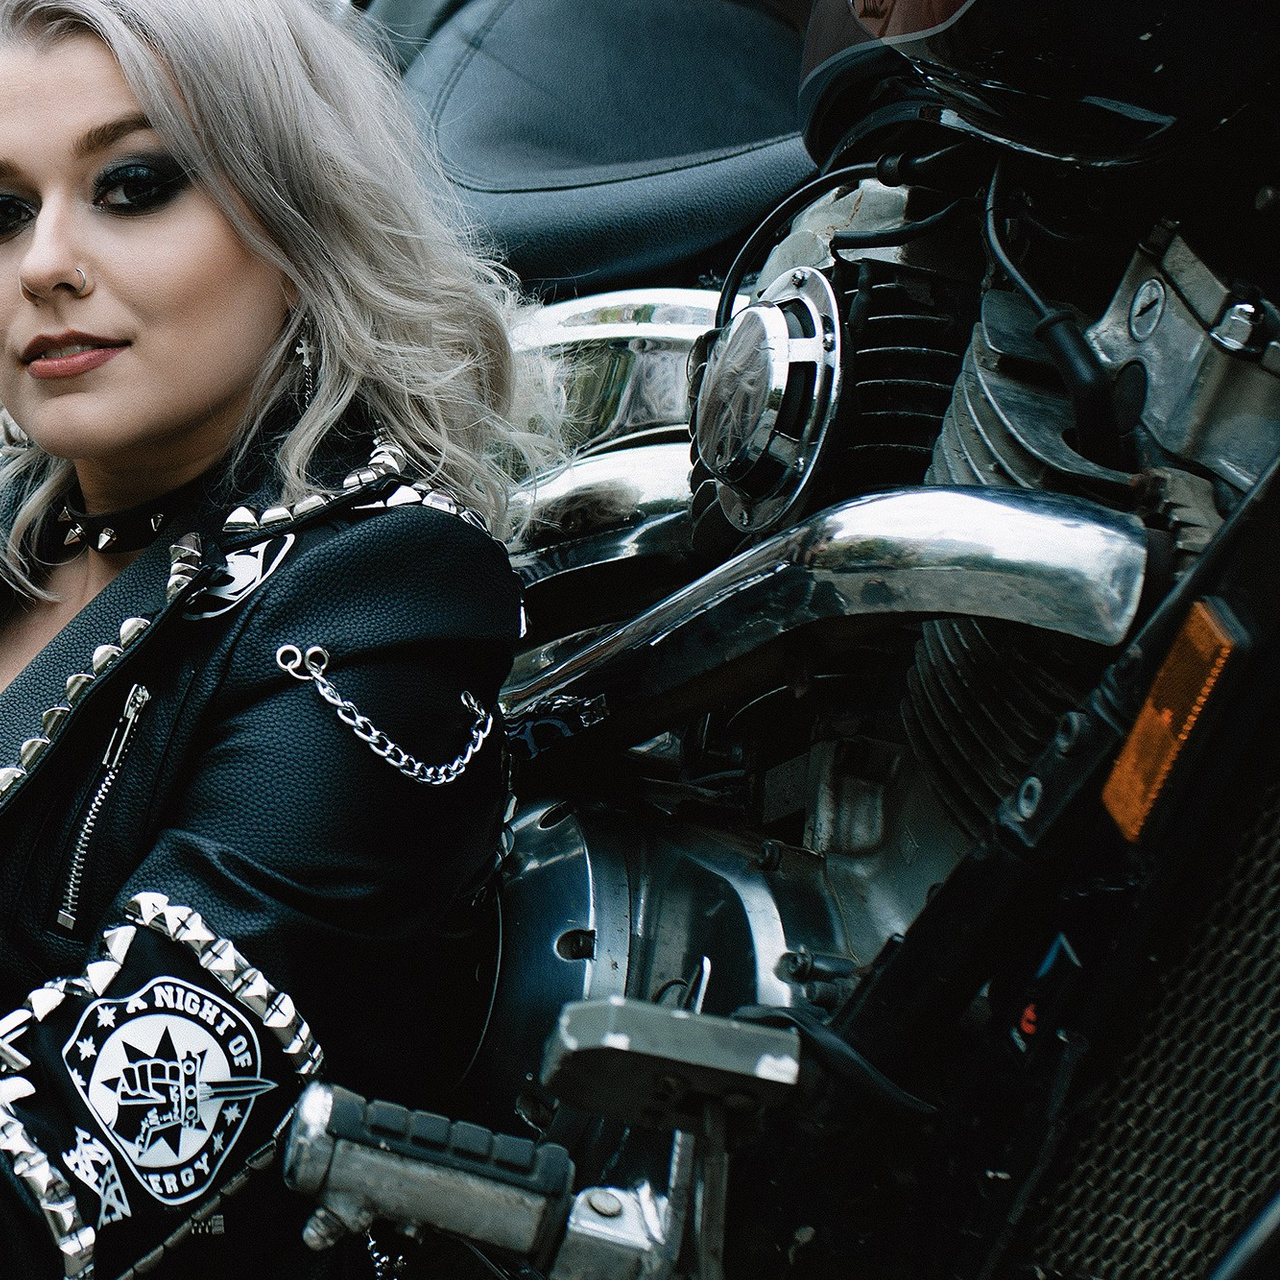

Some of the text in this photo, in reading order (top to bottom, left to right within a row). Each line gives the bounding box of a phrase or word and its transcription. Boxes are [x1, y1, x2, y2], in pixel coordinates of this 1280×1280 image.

[126, 985, 253, 1069] A NIGHT OF
[143, 1153, 211, 1195] ERGY
